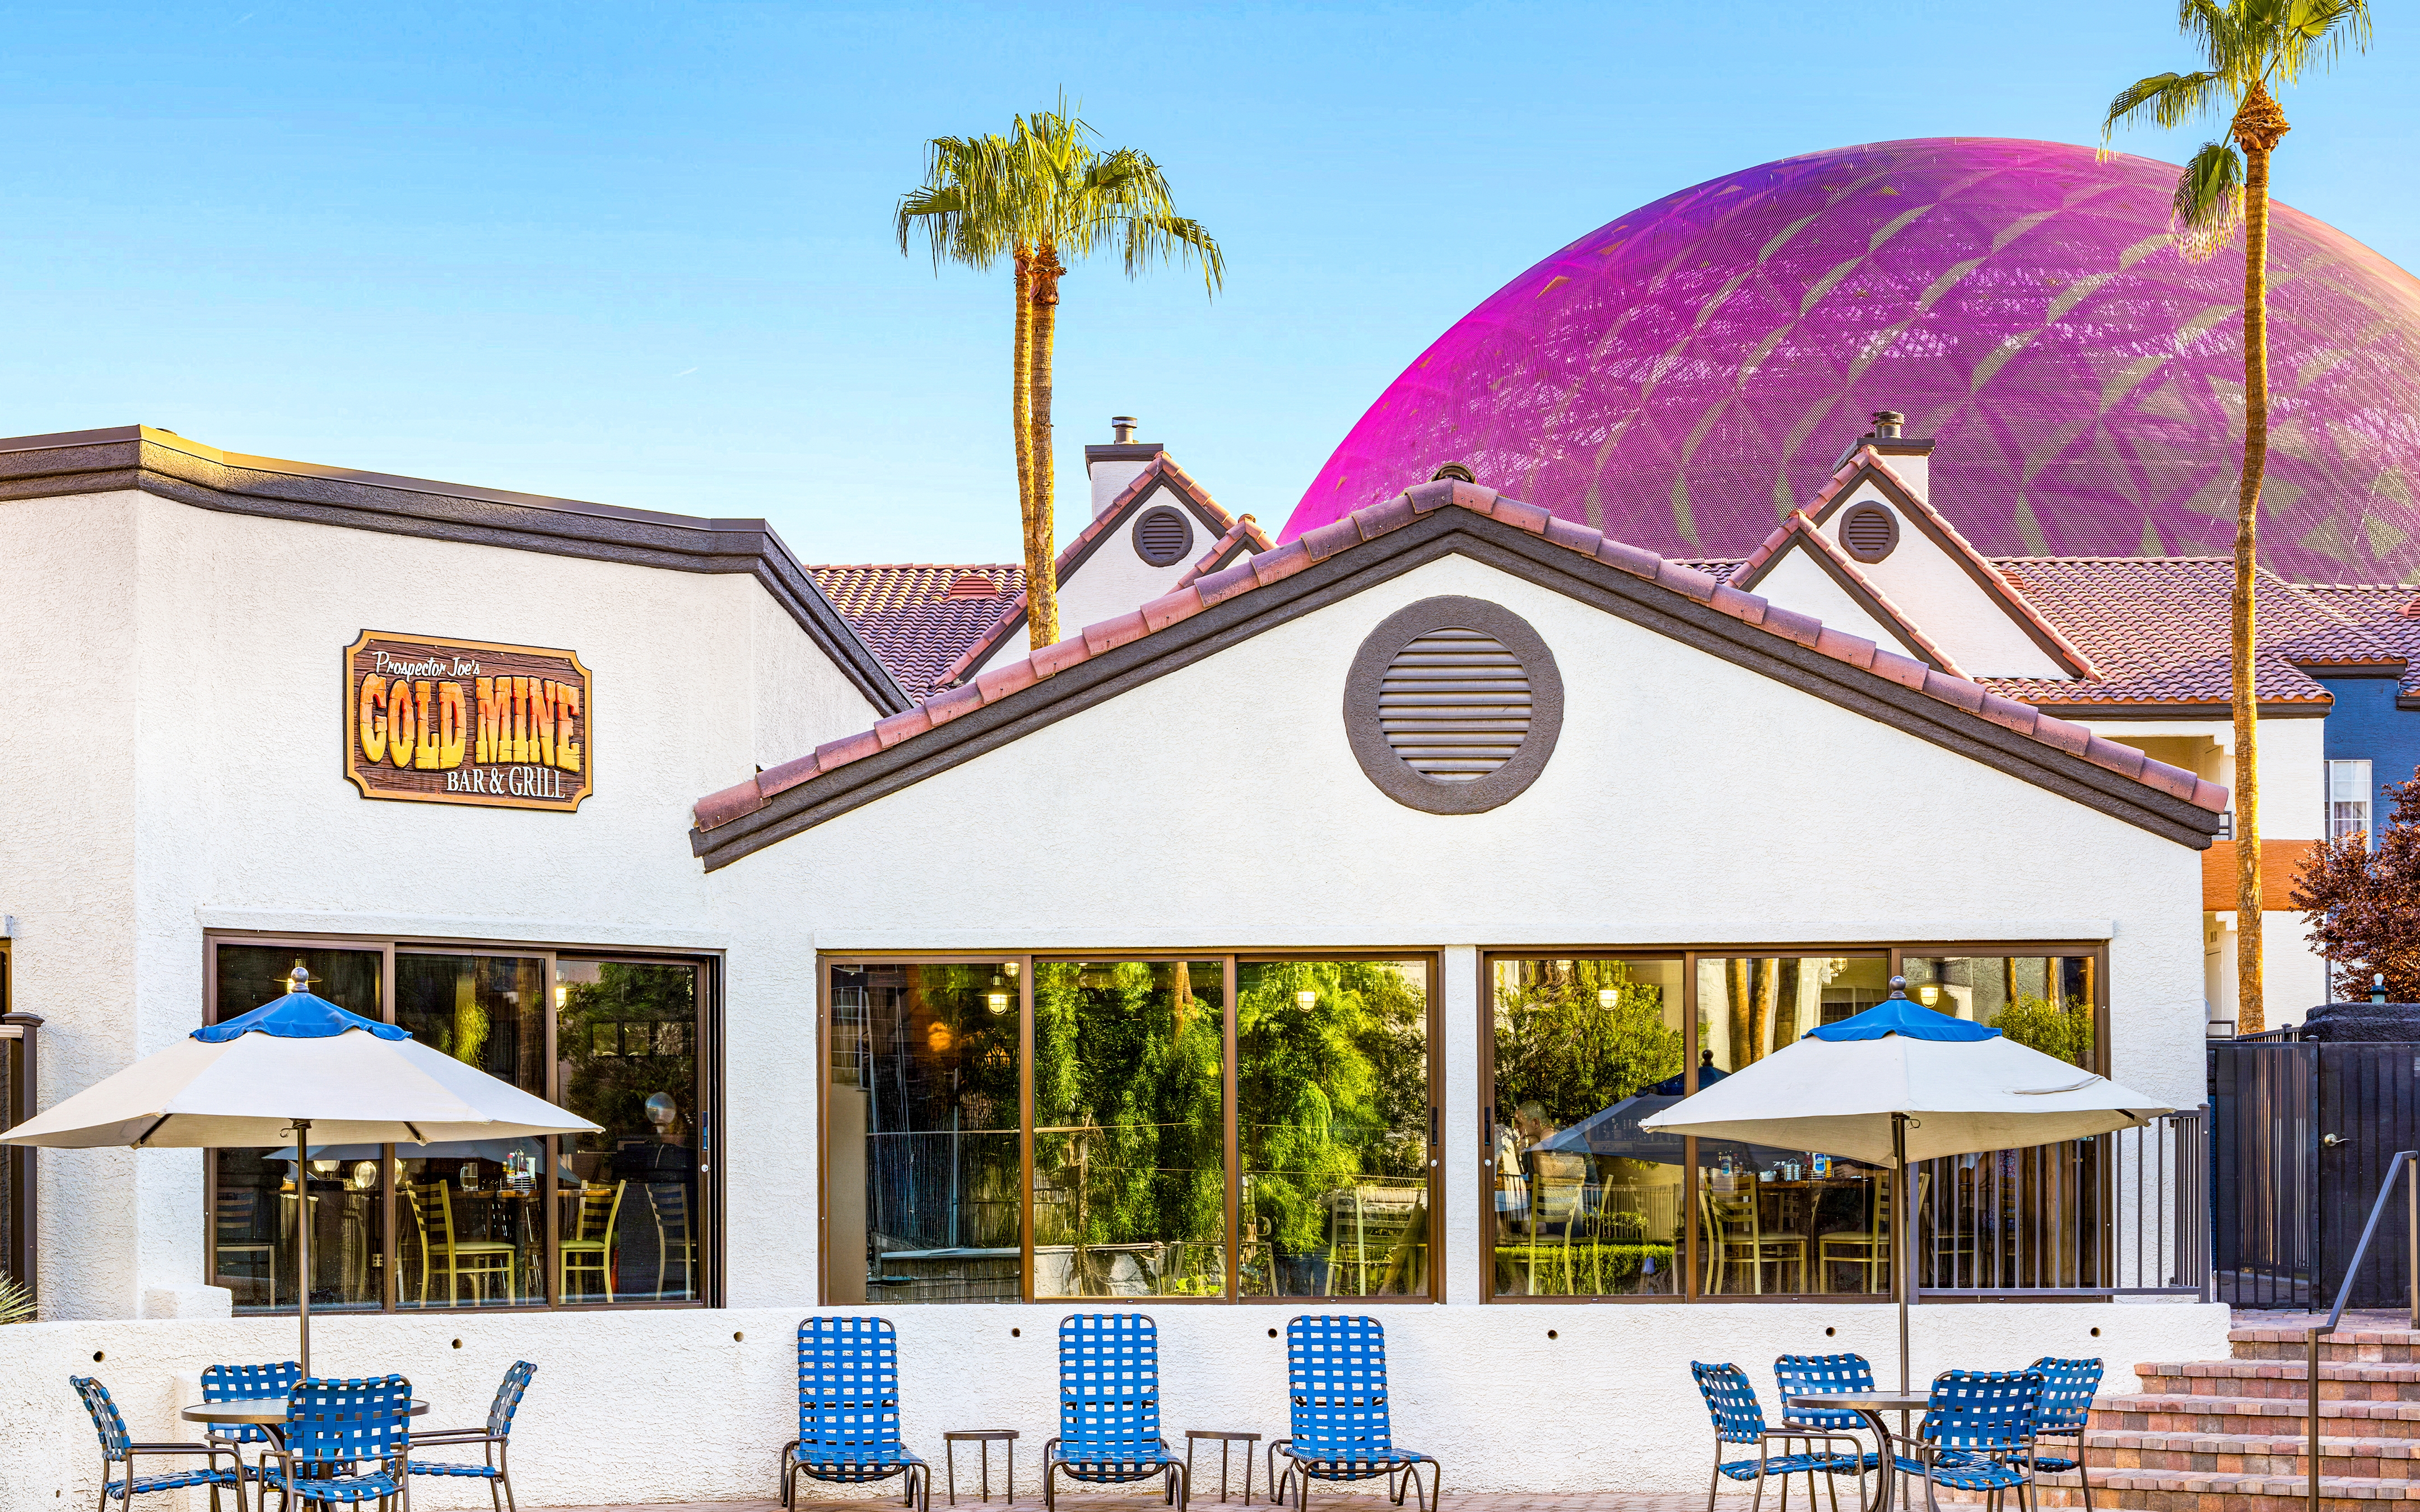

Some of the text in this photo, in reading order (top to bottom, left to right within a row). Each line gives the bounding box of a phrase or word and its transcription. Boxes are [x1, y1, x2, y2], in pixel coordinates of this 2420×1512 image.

[372, 651, 480, 682] Prospector Joe's
[360, 673, 580, 772] GOLD MINE
[446, 766, 566, 799] BAR & GRILL
